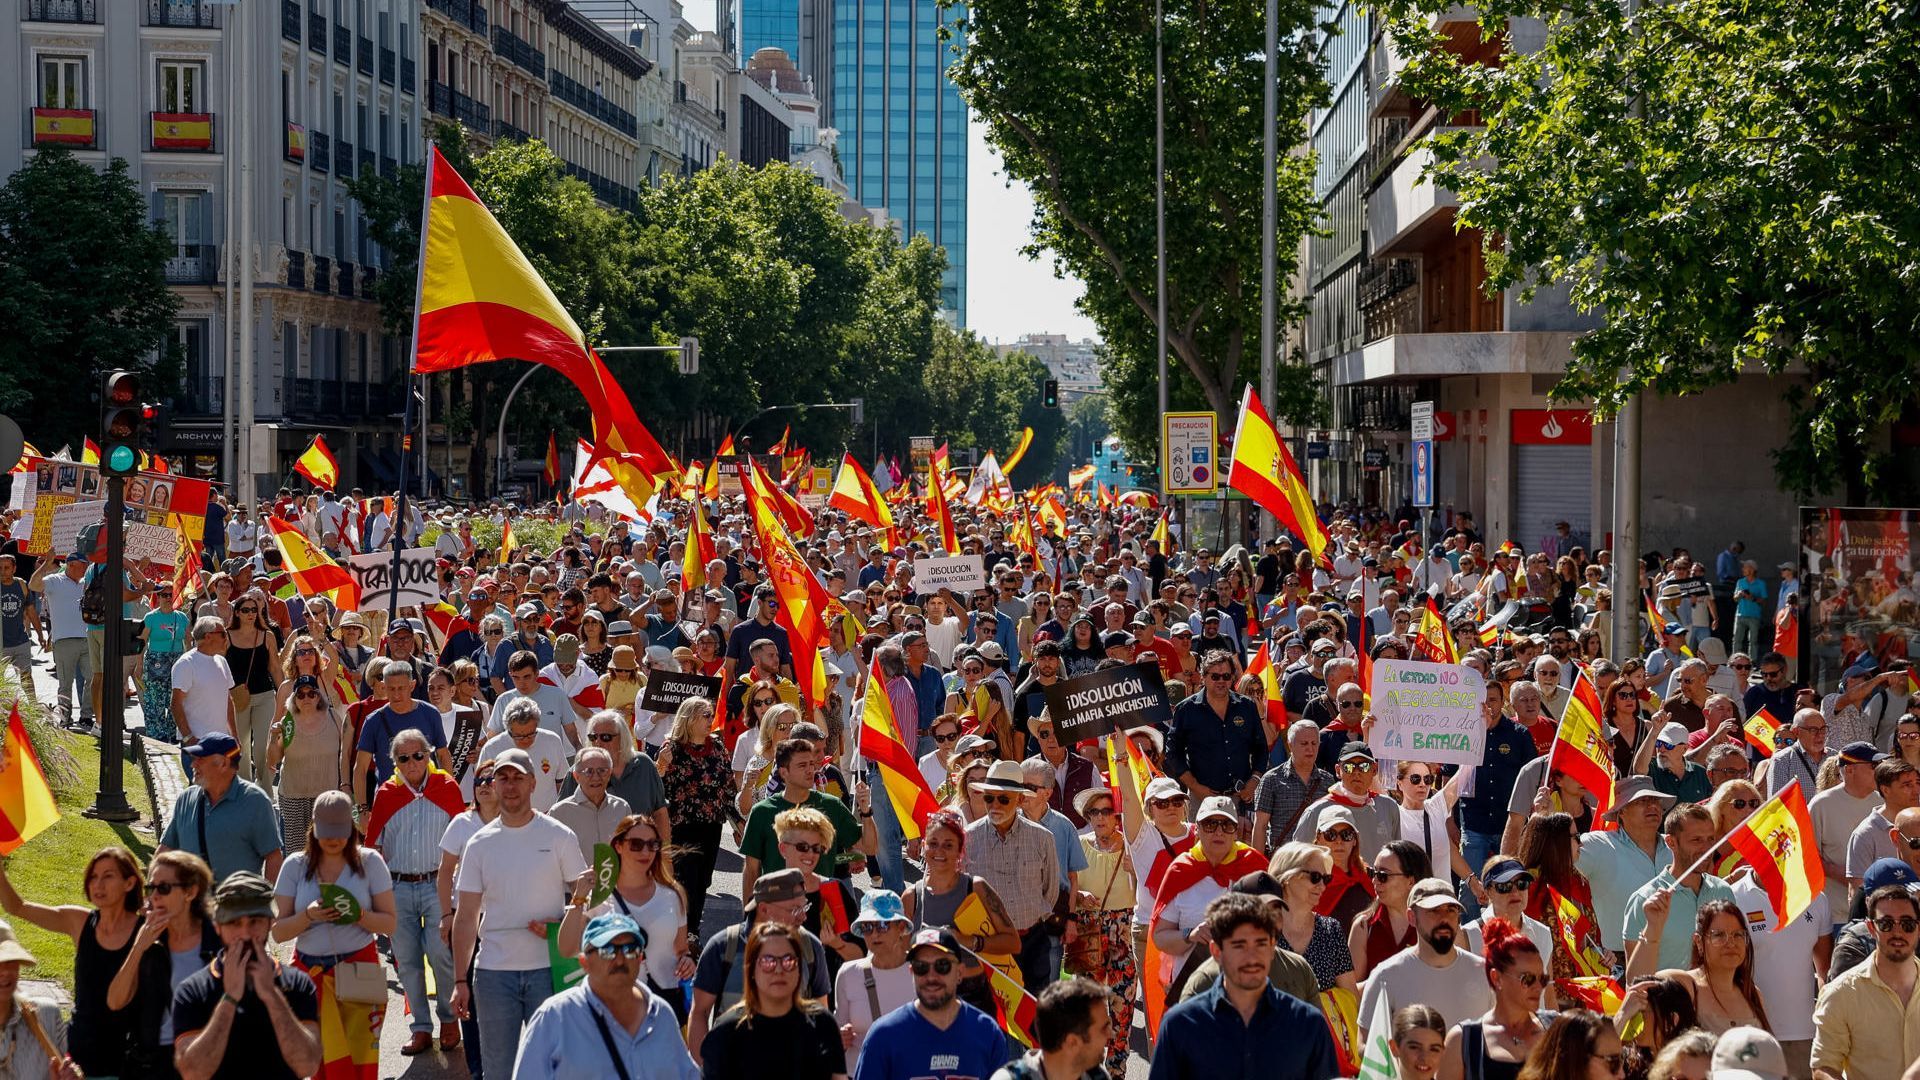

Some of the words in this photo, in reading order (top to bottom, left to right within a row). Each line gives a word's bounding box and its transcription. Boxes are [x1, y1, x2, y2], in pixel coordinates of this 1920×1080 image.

[1399, 671, 1437, 685] VERDAD
[1439, 671, 1459, 685] NO
[1065, 677, 1144, 711] ¡DISOLUCIÓN
[1305, 685, 1328, 694] JAC
[662, 694, 680, 704] MAFIA
[1061, 719, 1069, 729] DE
[1070, 718, 1077, 726] LA
[1076, 708, 1105, 725] MAFIA
[1105, 694, 1159, 717] SANCHISTA!!
[1456, 712, 1480, 730] dar
[599, 857, 614, 892] VOX
[333, 894, 354, 917] VOX
[929, 1054, 960, 1070] GIANTS
